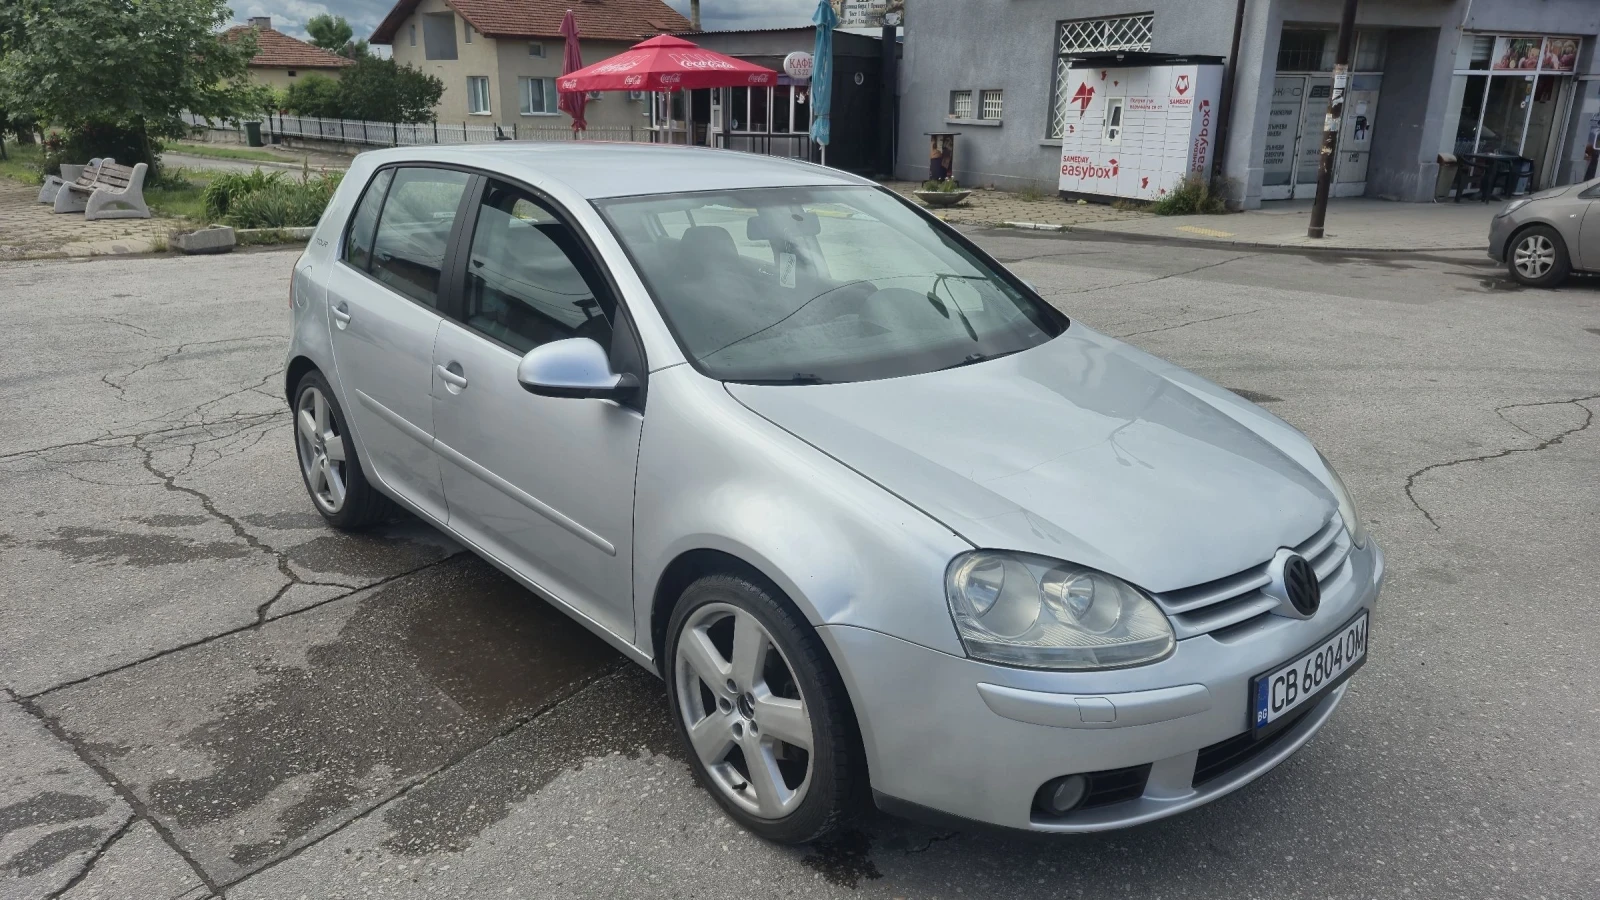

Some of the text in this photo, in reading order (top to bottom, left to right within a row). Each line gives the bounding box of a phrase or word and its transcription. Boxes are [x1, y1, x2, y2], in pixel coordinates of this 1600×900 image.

[790, 58, 813, 69] КАФЕ
[1196, 109, 1211, 173] easybox
[1063, 156, 1090, 164] SAMEDAY
[1191, 138, 1199, 172] SAMEDAY
[1061, 163, 1111, 180] easybox
[1271, 619, 1365, 713] CB 6804 OM
[1257, 708, 1268, 723] BG
